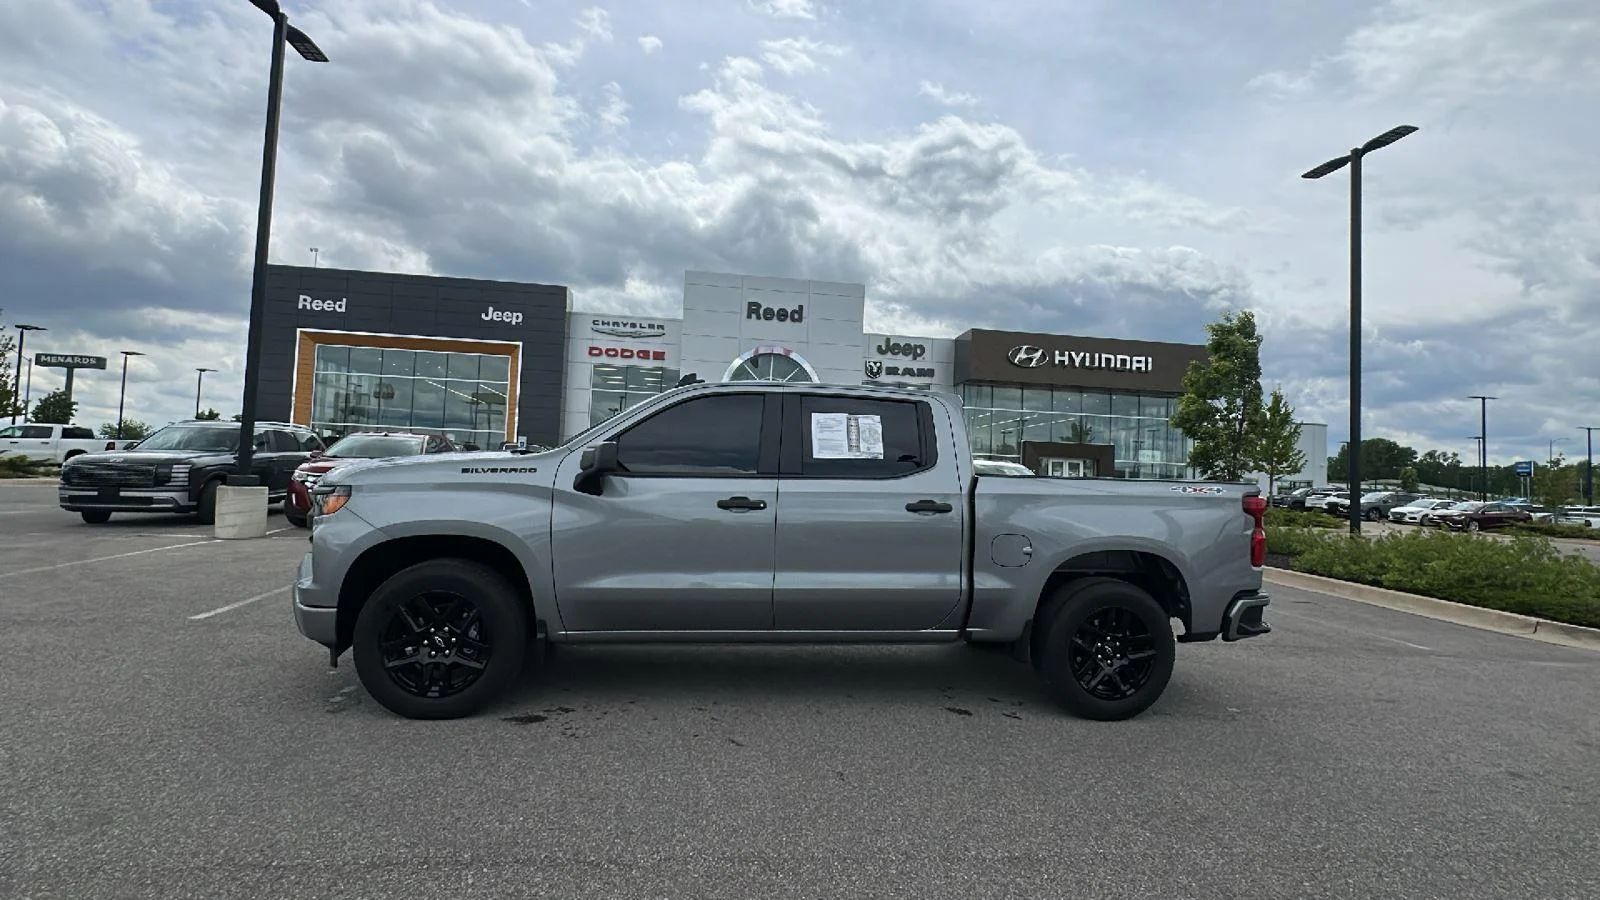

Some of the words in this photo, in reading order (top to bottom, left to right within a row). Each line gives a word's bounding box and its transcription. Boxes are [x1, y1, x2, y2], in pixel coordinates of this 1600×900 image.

[298, 294, 347, 313] Reed
[746, 301, 804, 323] Reed
[481, 306, 523, 325] Jeep
[592, 319, 665, 330] CHRYSLER
[588, 346, 666, 361] DODGE
[876, 337, 926, 360] Jeep
[40, 355, 97, 365] MENARDS
[1054, 350, 1153, 371] HYUNDAI
[885, 366, 935, 378] RAM
